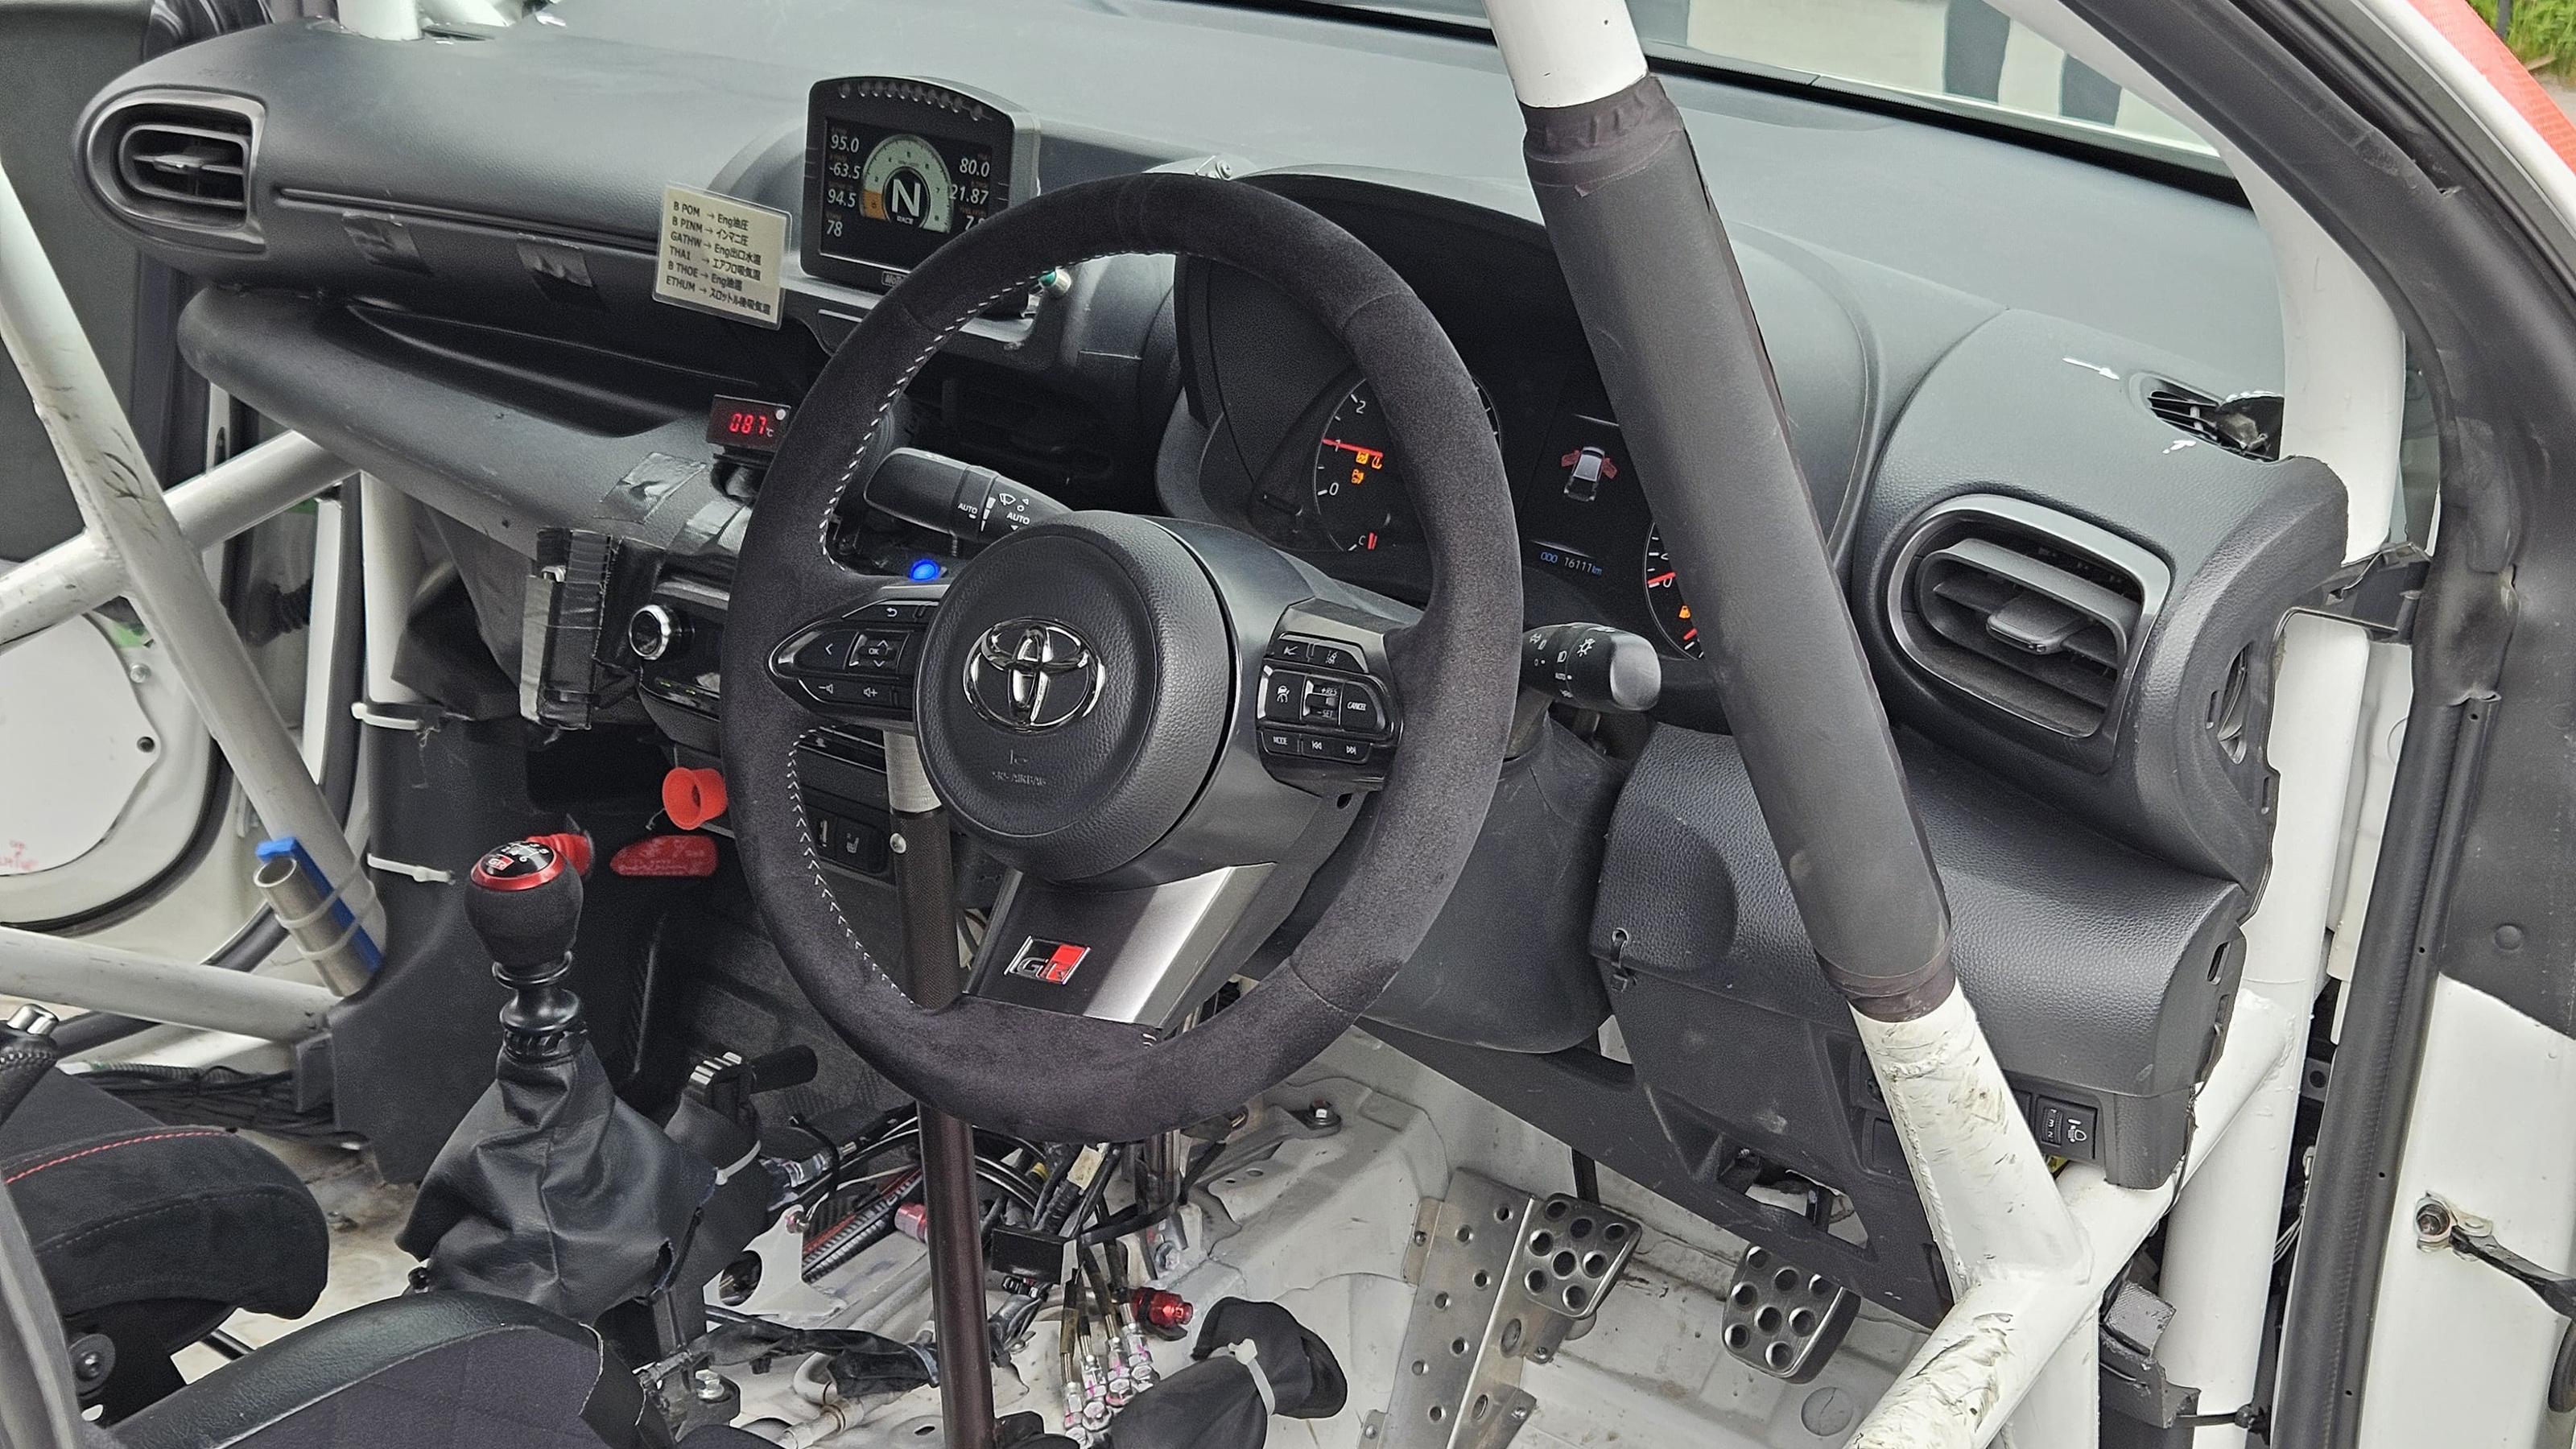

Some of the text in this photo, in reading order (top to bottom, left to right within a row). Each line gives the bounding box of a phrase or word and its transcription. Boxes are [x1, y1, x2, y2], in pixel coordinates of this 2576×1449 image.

[831, 134, 860, 153] 95.0
[829, 162, 861, 180] -63.5
[960, 158, 990, 178] 80.0
[828, 188, 856, 208] 94.5
[891, 178, 921, 217] N
[951, 184, 989, 205] 21.87
[674, 201, 749, 231] B POM Eng油圧
[897, 215, 914, 225] RACE
[672, 217, 749, 246] B PINM インマニ圧
[826, 220, 843, 237] 78
[671, 232, 702, 248] GATHW
[669, 246, 691, 261] THA1
[668, 261, 674, 270] B
[676, 262, 699, 278] THOE
[667, 275, 695, 292] ETHUM
[1356, 400, 1366, 414] 2
[729, 411, 767, 435] 087
[1329, 482, 1340, 496] 0
[957, 502, 978, 514] AUTO
[1007, 511, 1030, 526] AUTO
[1358, 535, 1365, 546] C
[1541, 551, 1558, 564] ODO
[869, 647, 880, 655] OK
[1347, 701, 1367, 712] CANCEL
[1273, 736, 1289, 745] MODE
[488, 858, 506, 869] GR
[2048, 1118, 2054, 1128] 3
[2047, 1130, 2054, 1138] 2
